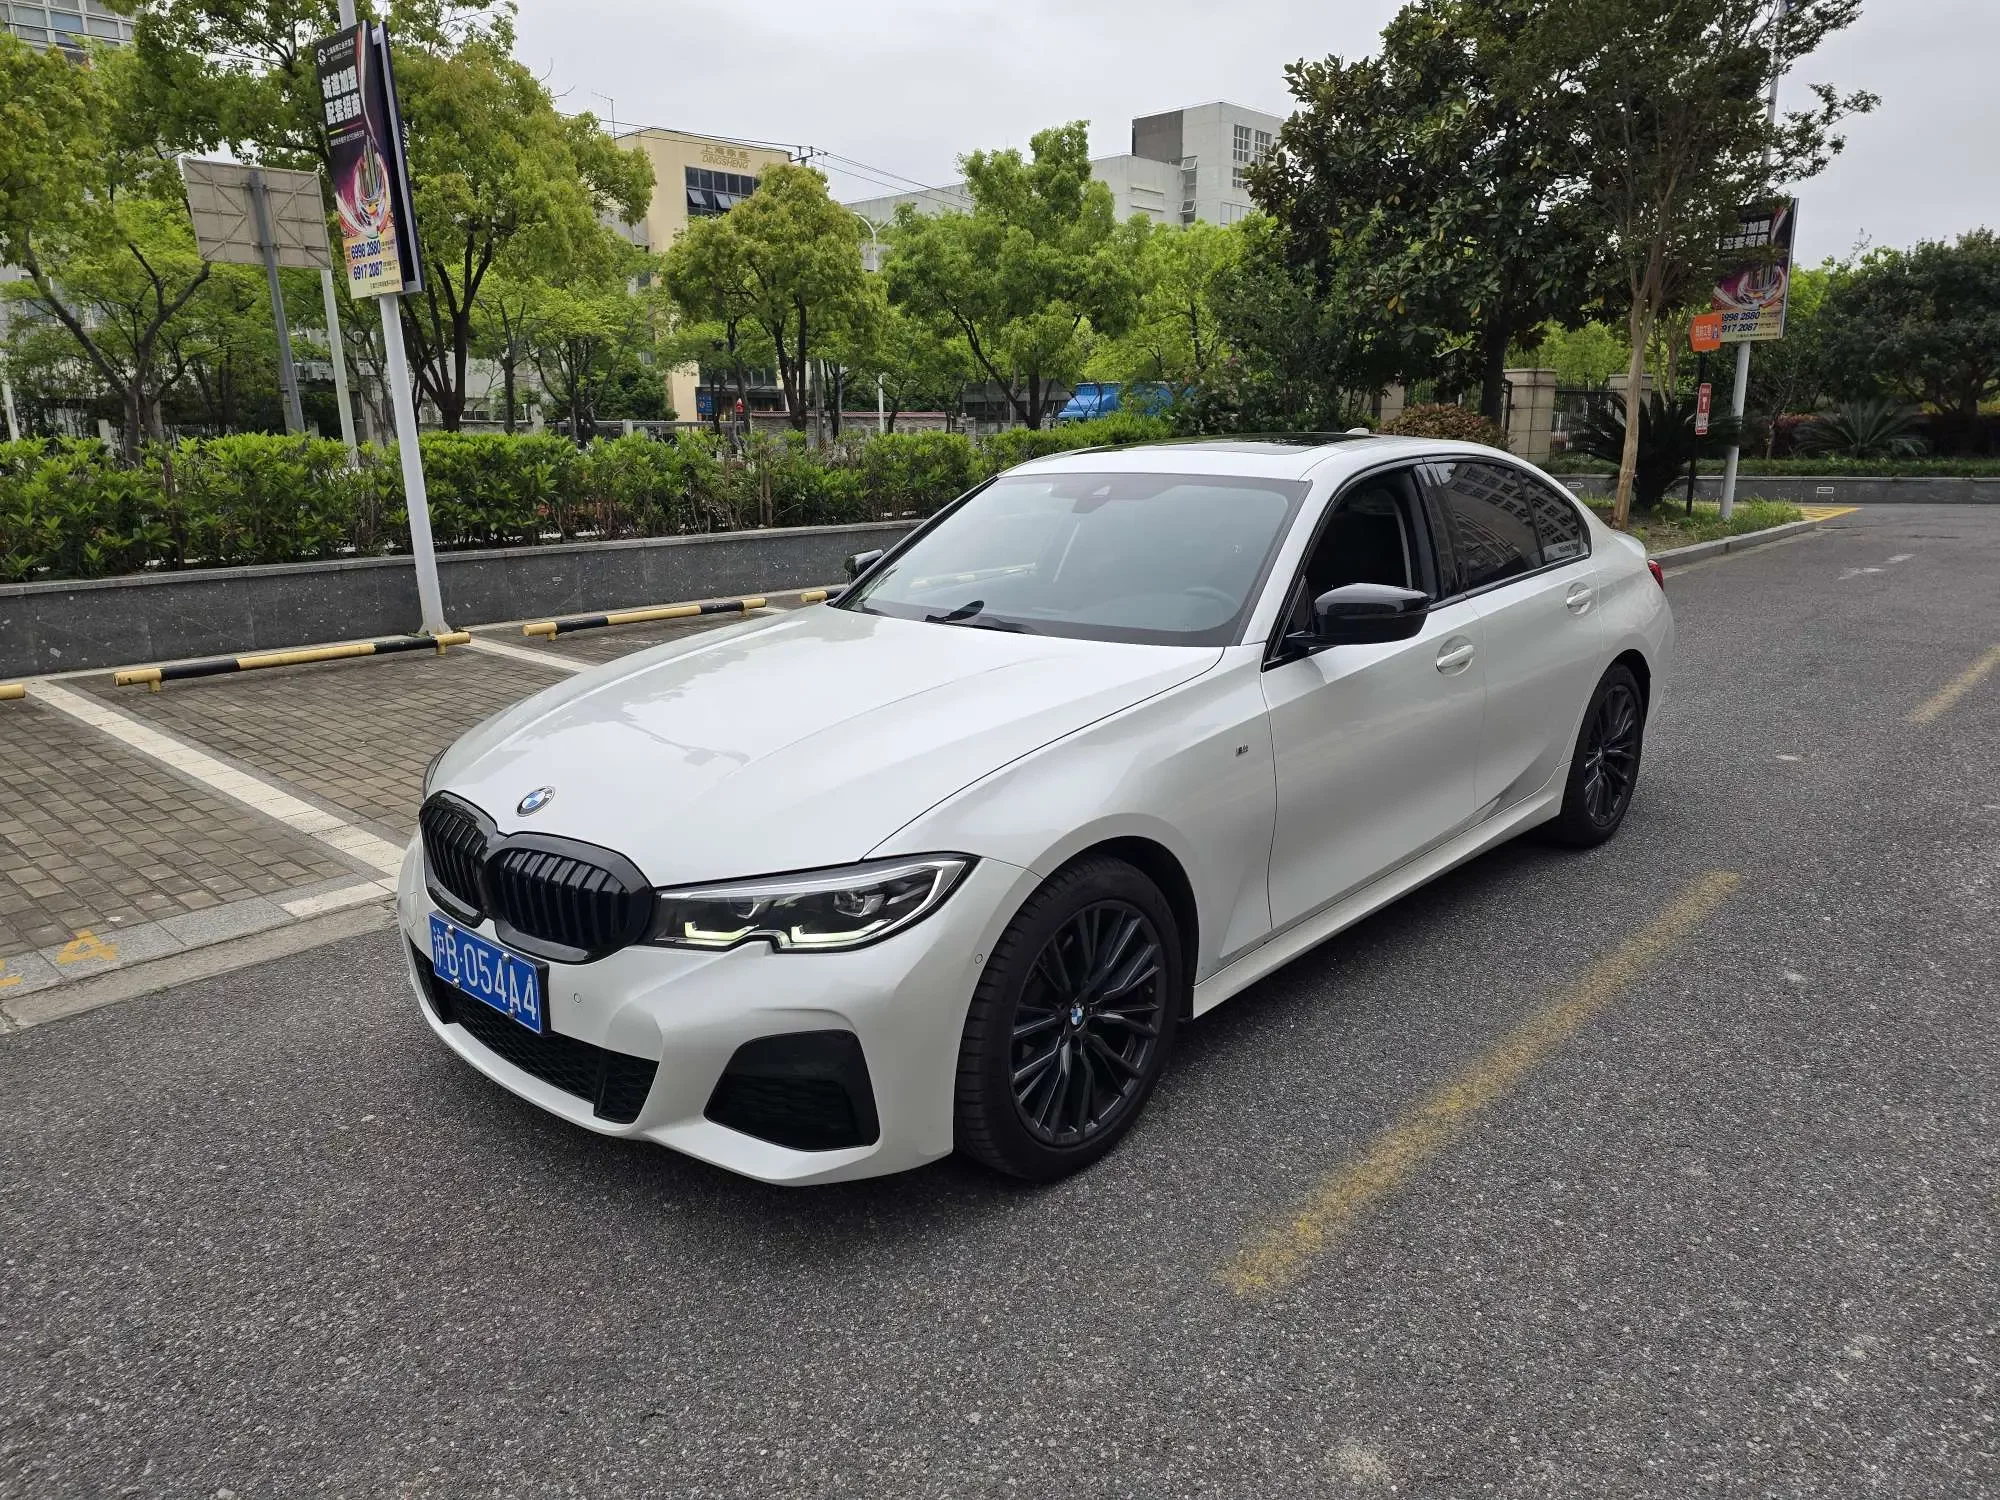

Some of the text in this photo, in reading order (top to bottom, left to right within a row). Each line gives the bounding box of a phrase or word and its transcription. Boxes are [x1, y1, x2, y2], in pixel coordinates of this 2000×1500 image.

[325, 93, 361, 126] 配套招商
[353, 264, 367, 280] 6917
[1720, 323, 1737, 332] 917
